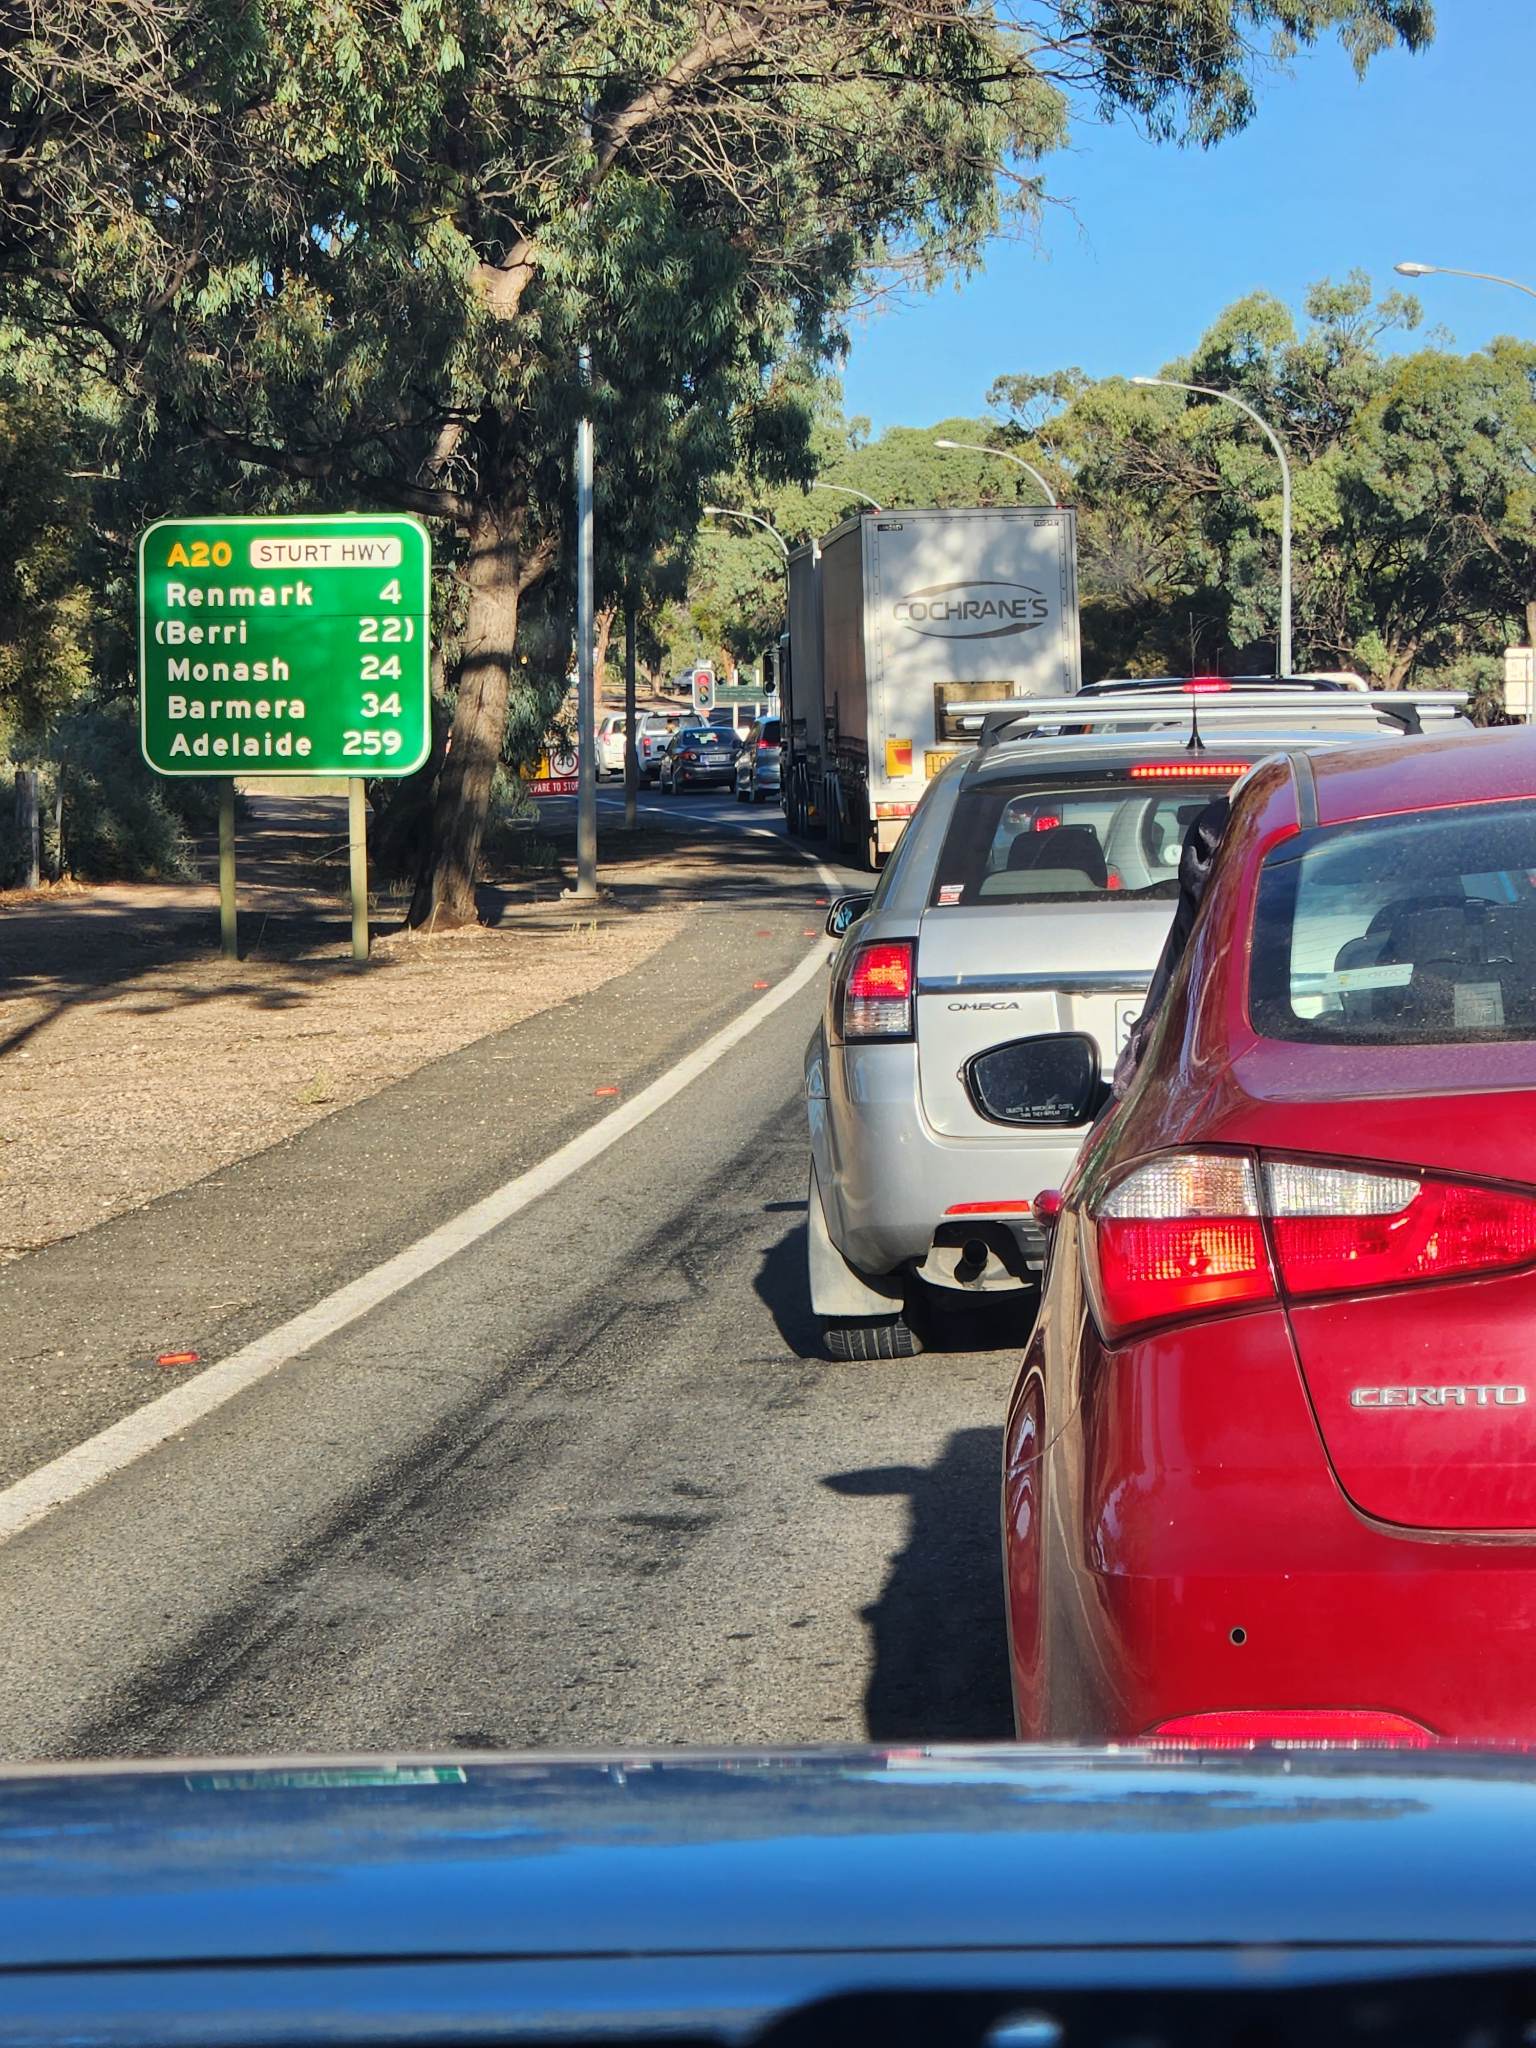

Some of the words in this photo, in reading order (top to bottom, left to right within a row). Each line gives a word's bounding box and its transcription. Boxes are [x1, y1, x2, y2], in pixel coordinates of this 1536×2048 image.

[166, 541, 232, 567] A20
[259, 545, 332, 562] STURT
[341, 543, 391, 561] HWY
[166, 582, 313, 607] Renmark
[378, 579, 402, 605] 4
[892, 598, 1049, 621] COCHRANE'S
[154, 619, 248, 645] (Berri
[357, 617, 414, 643] 22)
[167, 657, 289, 682] Monash
[359, 655, 402, 680] 24
[168, 695, 305, 719] Barmera
[359, 692, 402, 718] 34
[169, 732, 312, 757] Adelaide
[342, 729, 402, 756] 259
[552, 782, 561, 792] TO
[947, 1002, 1019, 1012] OMEGA
[1351, 1385, 1527, 1407] CERATO
